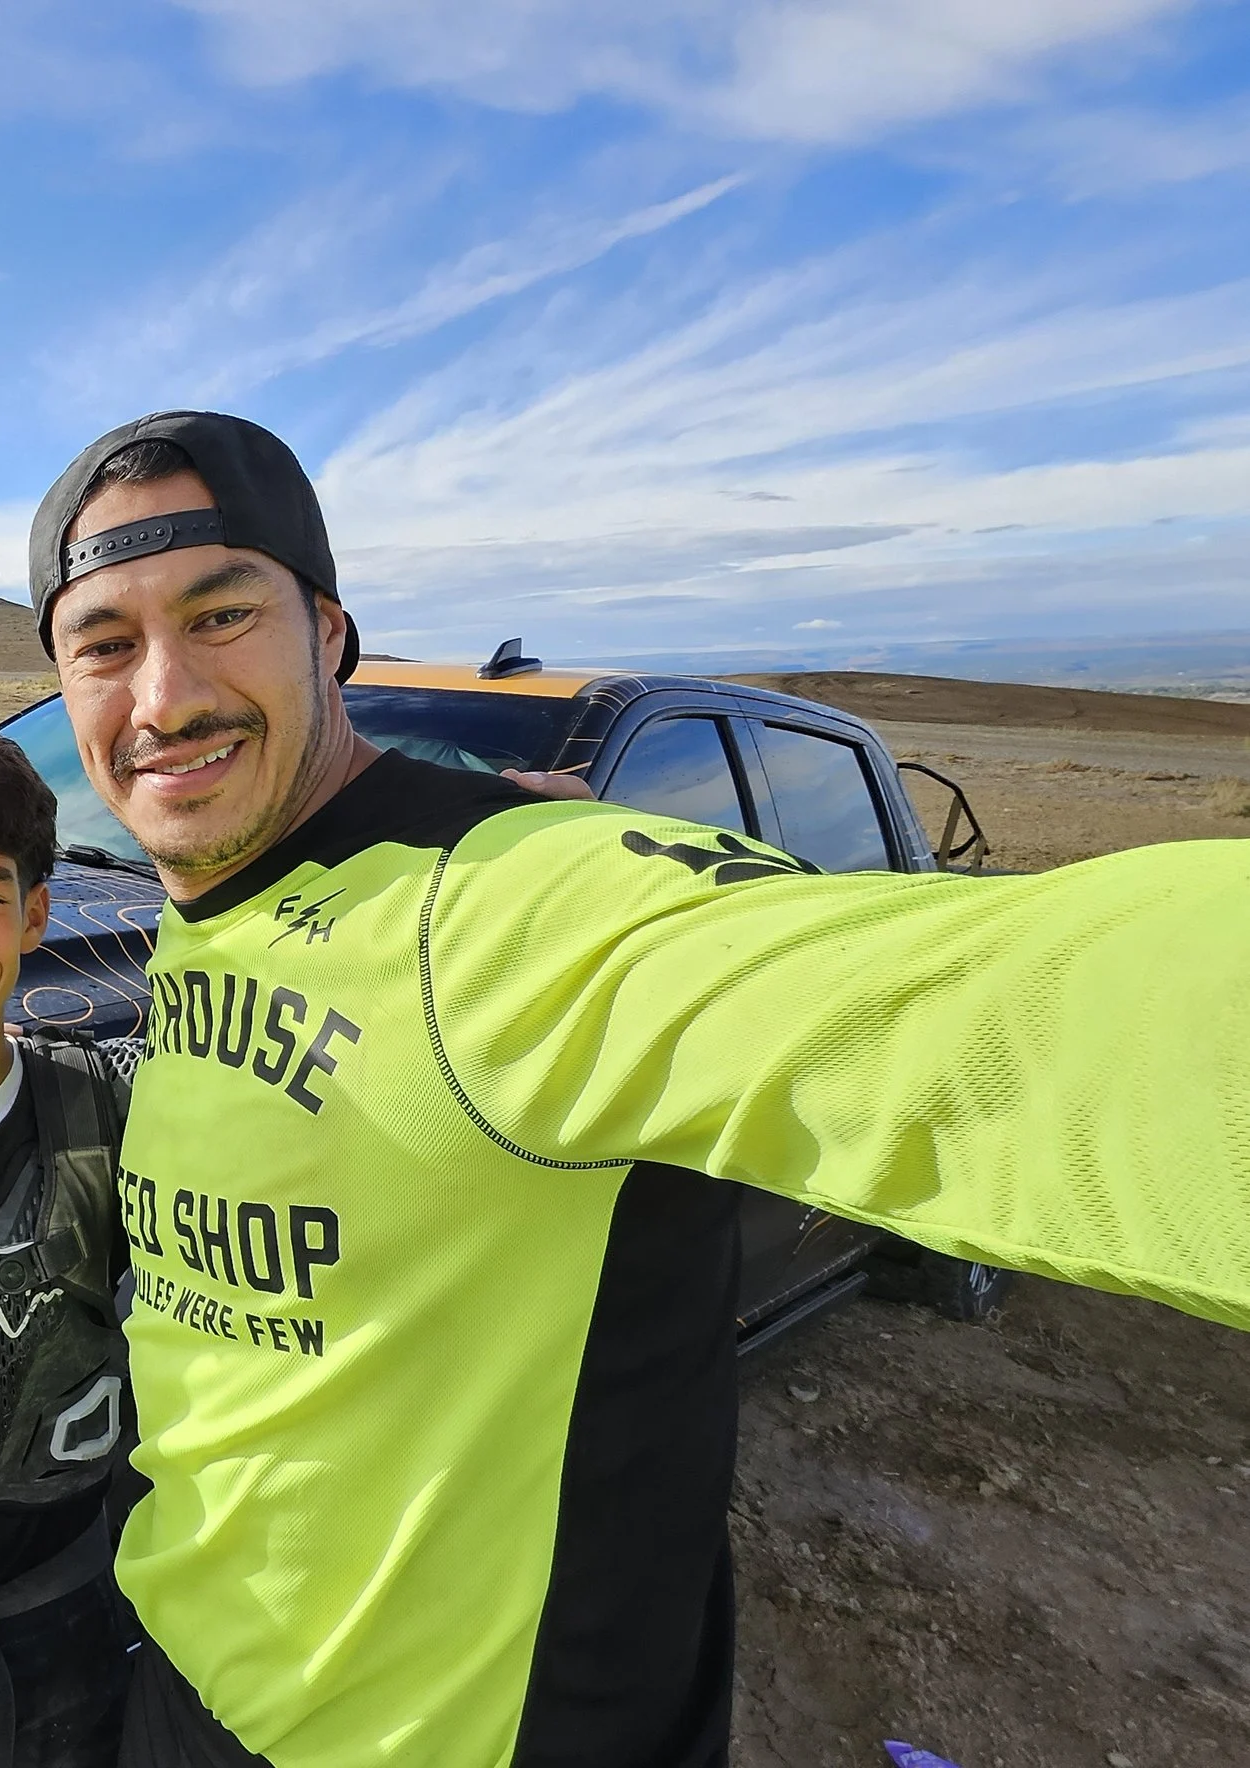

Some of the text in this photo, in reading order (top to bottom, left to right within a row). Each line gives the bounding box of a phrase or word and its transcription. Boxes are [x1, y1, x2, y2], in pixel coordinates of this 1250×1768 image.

[144, 970, 363, 1116] HOUSE
[173, 1188, 341, 1300] SHOP
[135, 1262, 324, 1358] ULES WERE FEW
